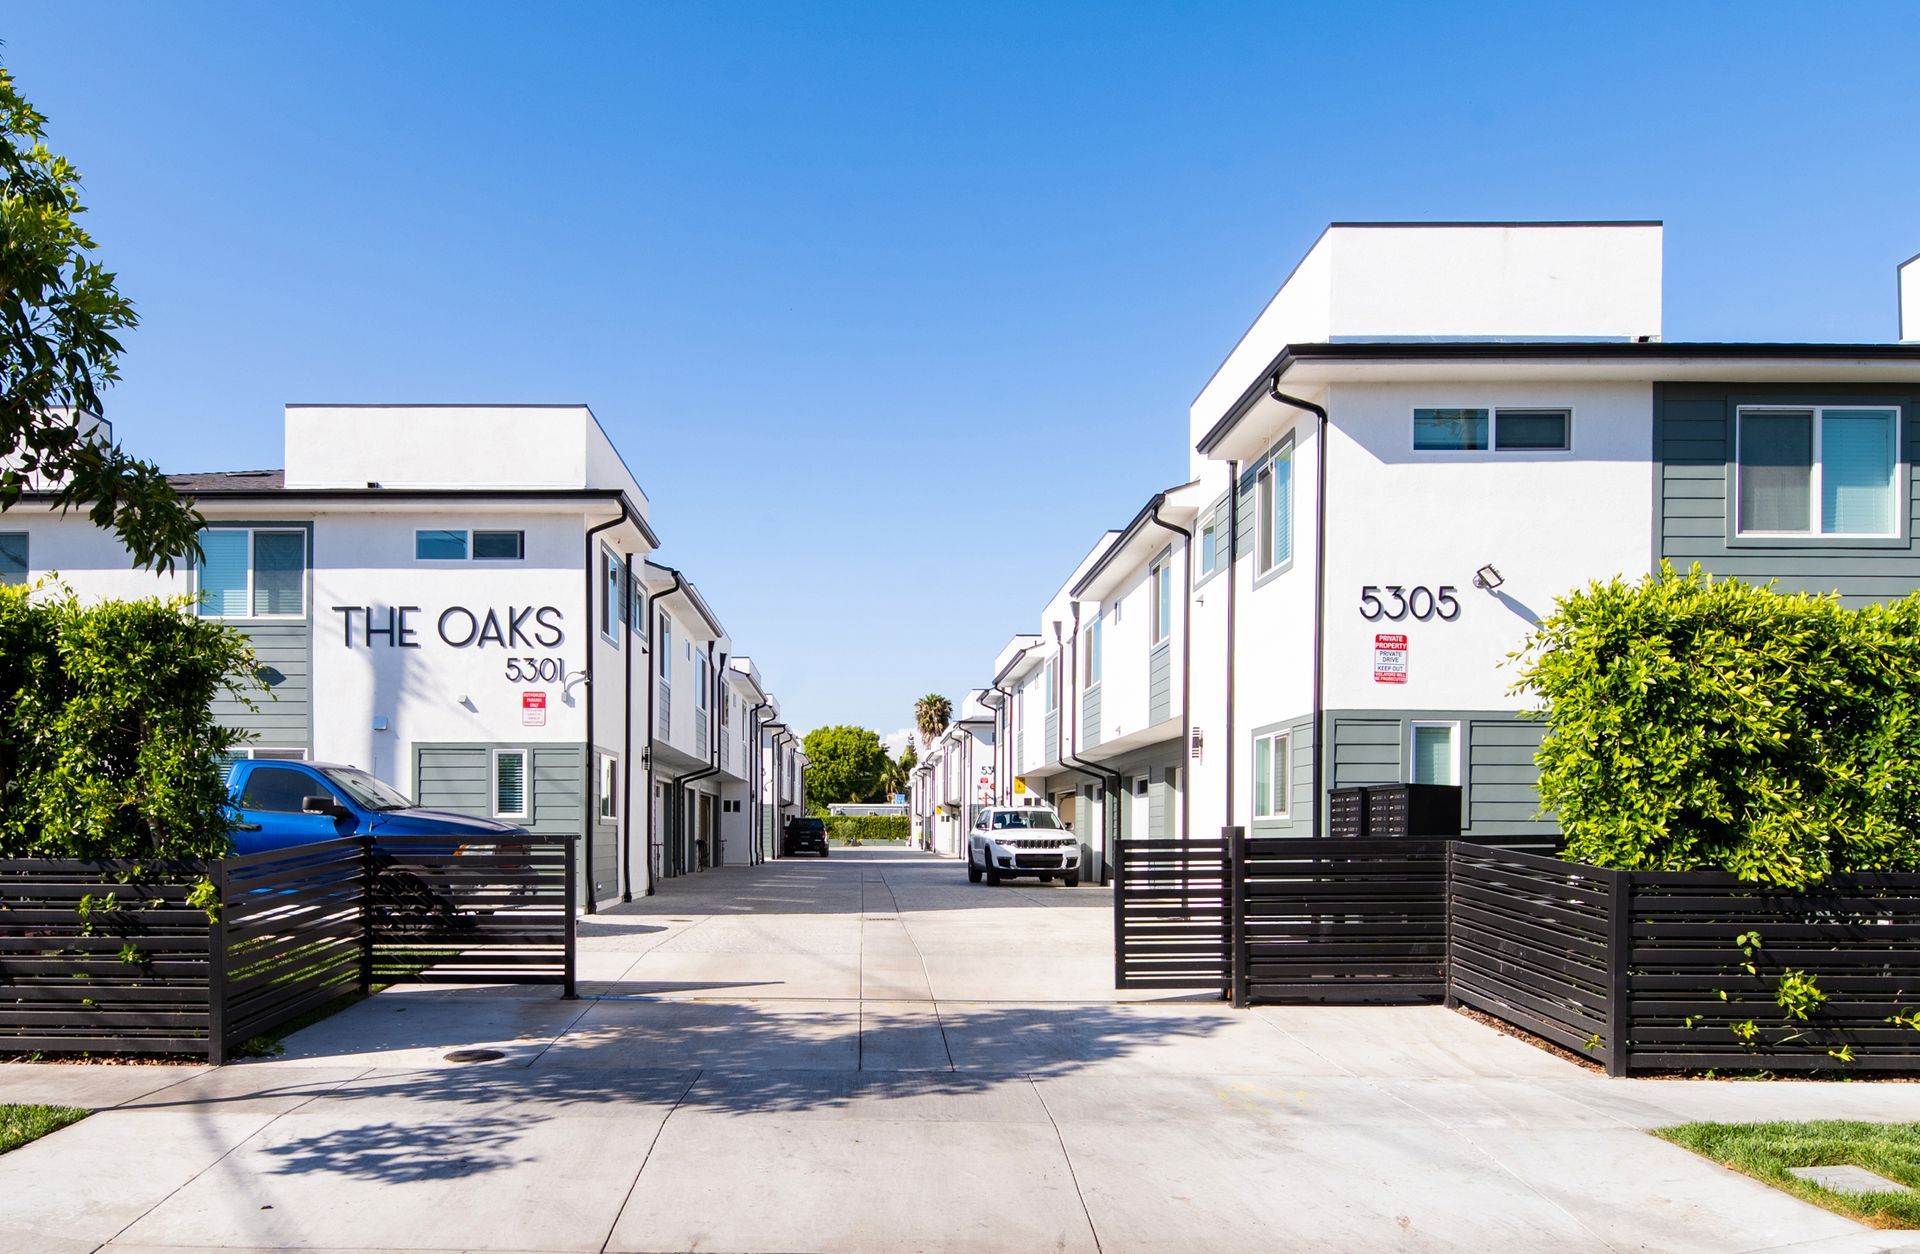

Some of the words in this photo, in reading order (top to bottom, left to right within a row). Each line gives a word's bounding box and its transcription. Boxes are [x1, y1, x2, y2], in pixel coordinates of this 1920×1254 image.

[1359, 585, 1459, 620] 5305
[331, 606, 419, 648] THE
[437, 606, 563, 648] OAKS
[505, 657, 563, 682] 5301
